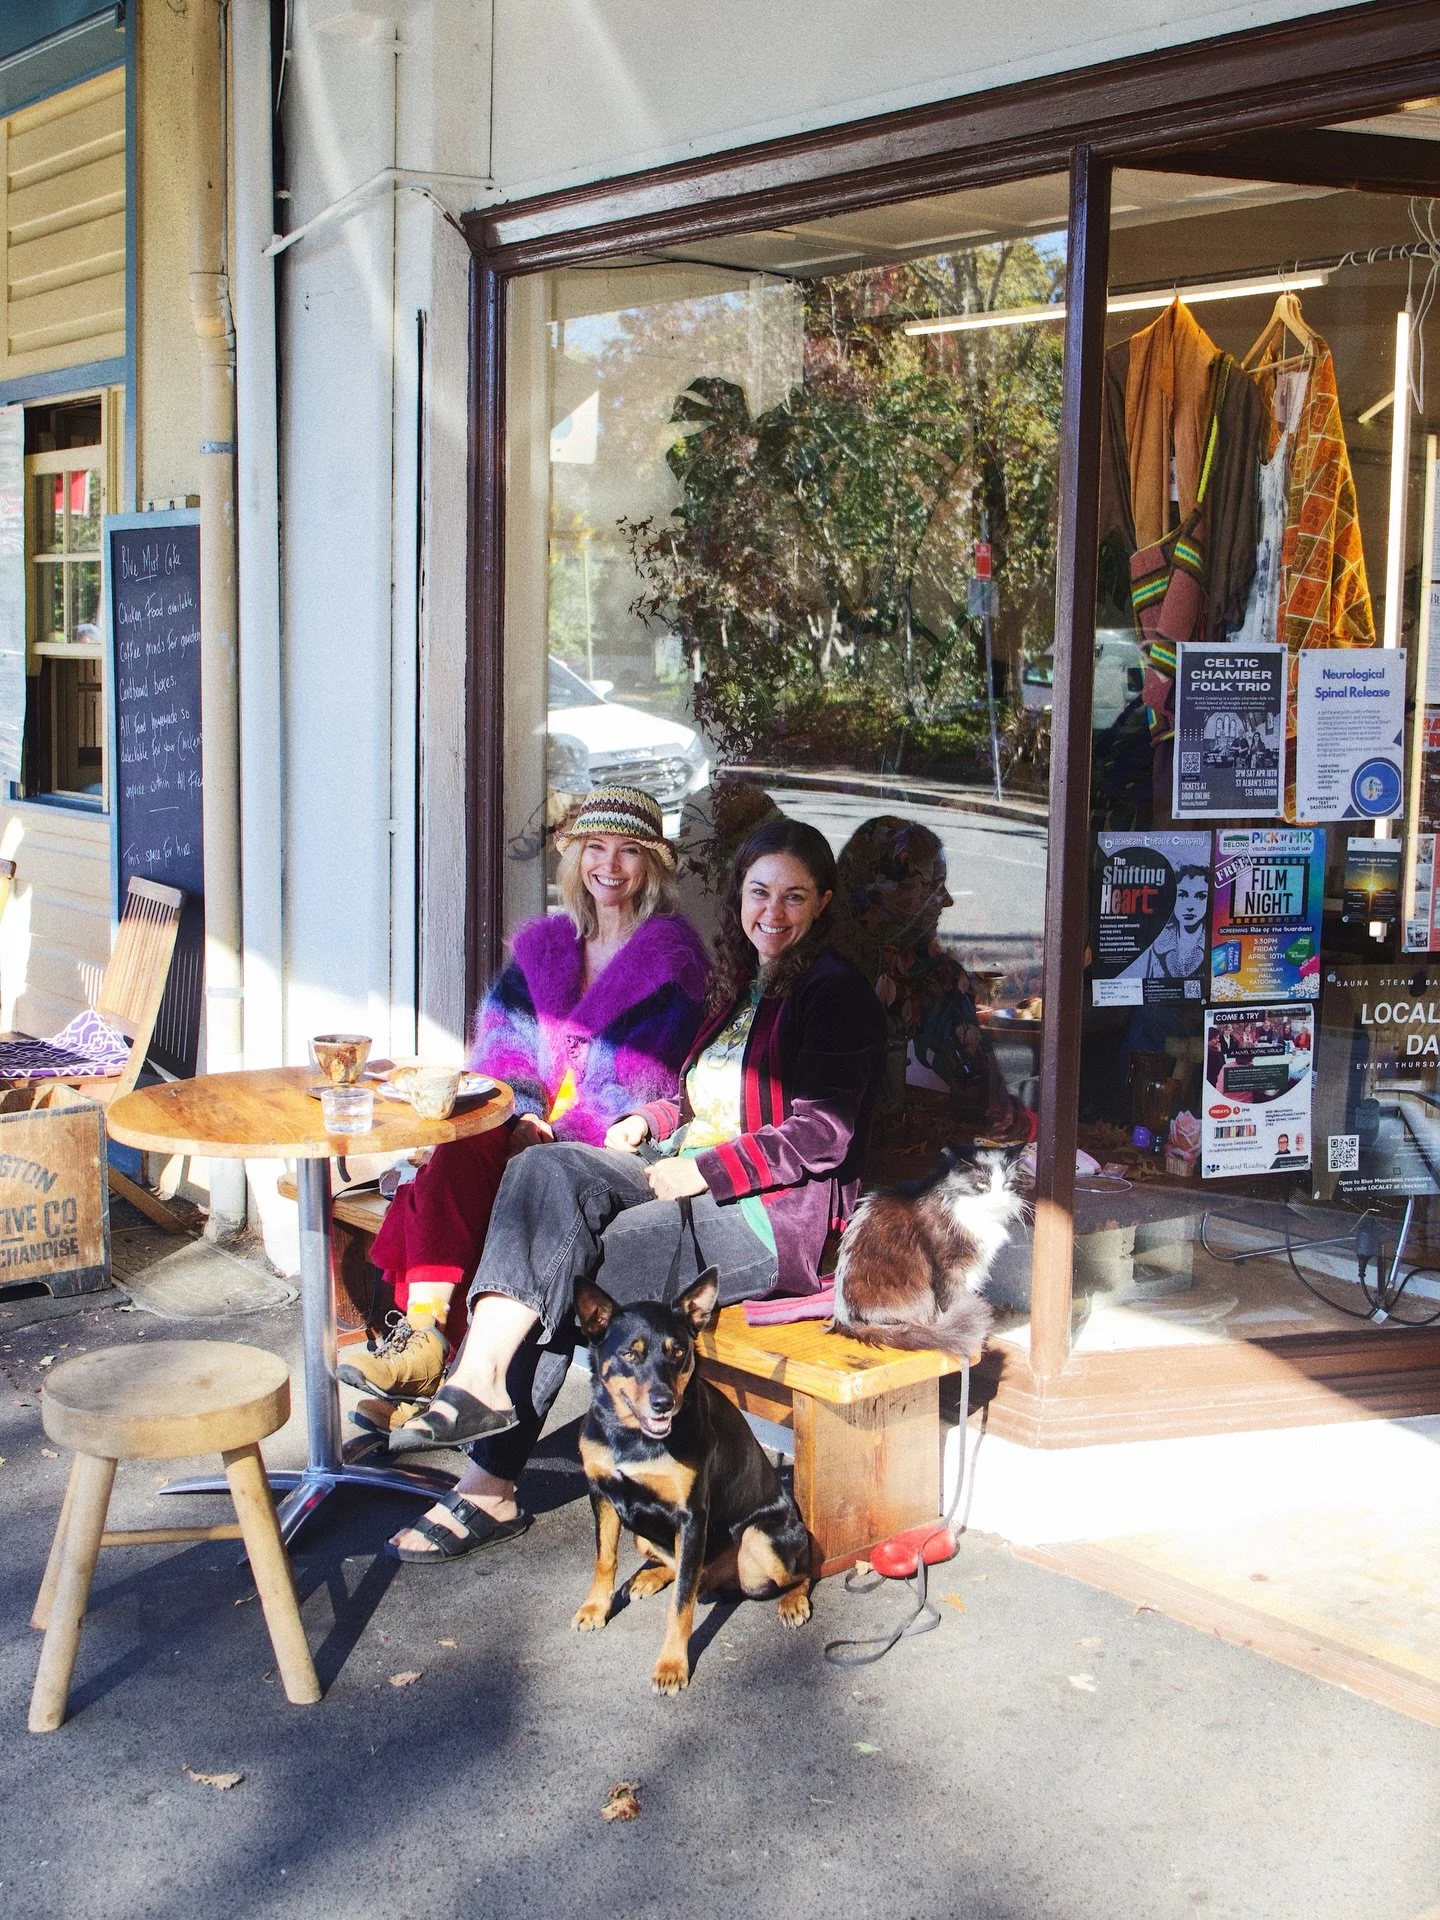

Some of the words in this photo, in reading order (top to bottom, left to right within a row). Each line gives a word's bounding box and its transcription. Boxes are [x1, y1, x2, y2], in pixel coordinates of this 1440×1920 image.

[122, 545, 138, 579] Blue
[142, 544, 159, 583] Mist
[118, 602, 142, 630] Chicken
[120, 632, 141, 670] Coffee
[146, 634, 164, 669] grinds
[1204, 658, 1259, 668] CELTIC
[1190, 671, 1272, 680] CHAMBER
[1322, 668, 1385, 682] Neurological
[120, 676, 148, 702] Cardboard
[1191, 682, 1232, 692] FOLK
[1236, 682, 1271, 692] TRIO
[1315, 687, 1347, 701] Spinal
[1350, 686, 1390, 698] Release
[120, 714, 131, 736] All
[164, 741, 175, 774] your
[123, 842, 140, 866] This
[145, 849, 161, 874] space
[1114, 857, 1126, 865] The
[1216, 855, 1250, 882] FREE
[1103, 865, 1166, 886] Shifting
[1251, 868, 1287, 891] FILM
[1100, 885, 1159, 914] Heart
[1244, 892, 1293, 915] NIGHT
[1216, 1013, 1238, 1021] COME
[1246, 1012, 1259, 1020] TRY
[1361, 1002, 1440, 1025] LOCAL
[1406, 1034, 1440, 1055] DA
[1357, 1062, 1389, 1070] EVERY
